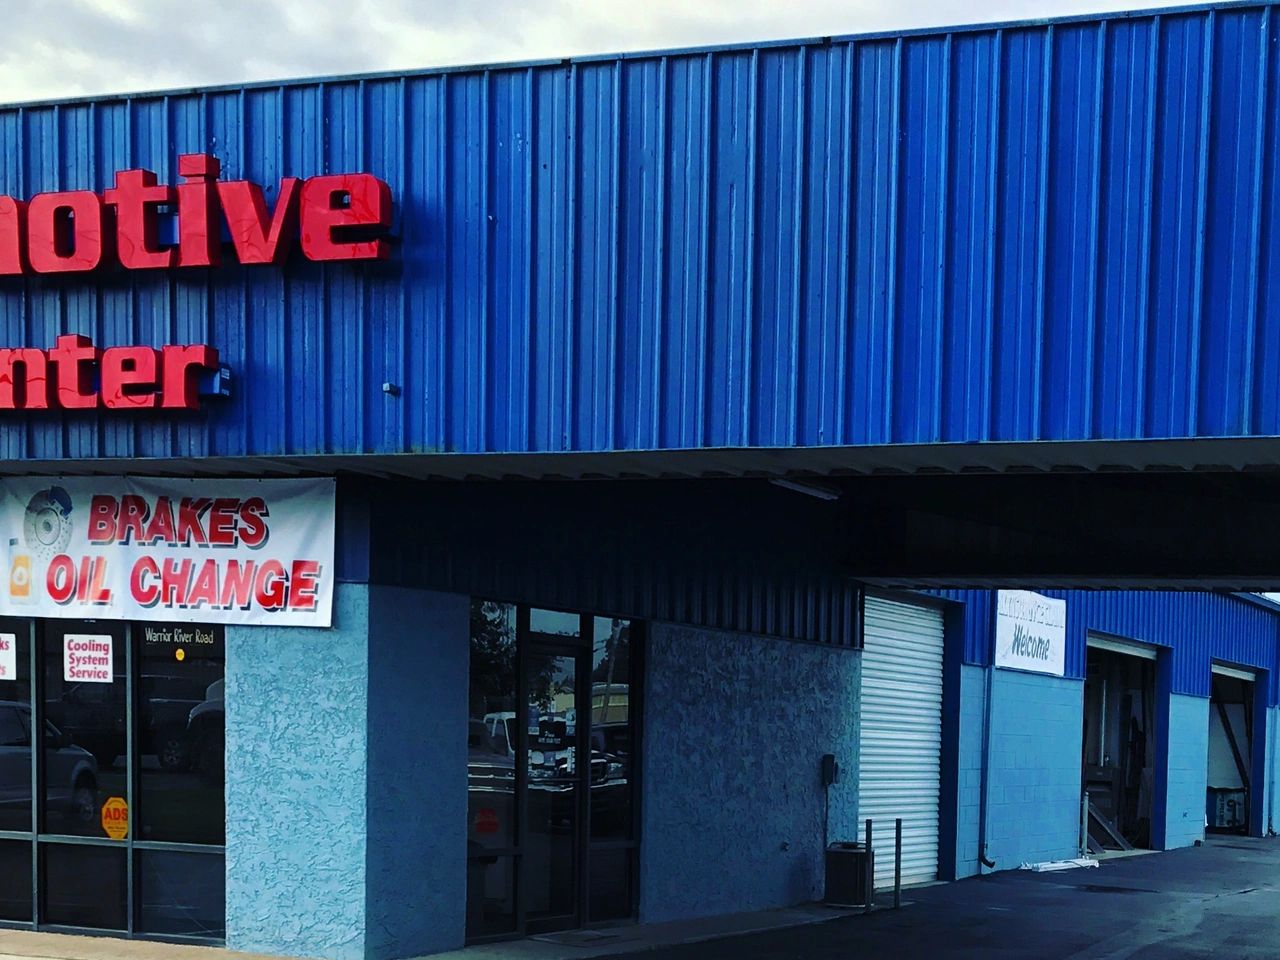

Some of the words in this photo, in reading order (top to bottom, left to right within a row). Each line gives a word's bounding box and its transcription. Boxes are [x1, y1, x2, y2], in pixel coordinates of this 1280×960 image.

[87, 494, 269, 550] BRAKES
[46, 554, 113, 606] OIL
[130, 555, 323, 612] CHANGE
[144, 627, 173, 642] Warrior
[173, 628, 194, 643] River
[195, 629, 214, 644] Road
[1011, 622, 1051, 661] Welcome
[67, 639, 110, 655] Cooling
[68, 652, 109, 667] System
[68, 666, 108, 679] Service
